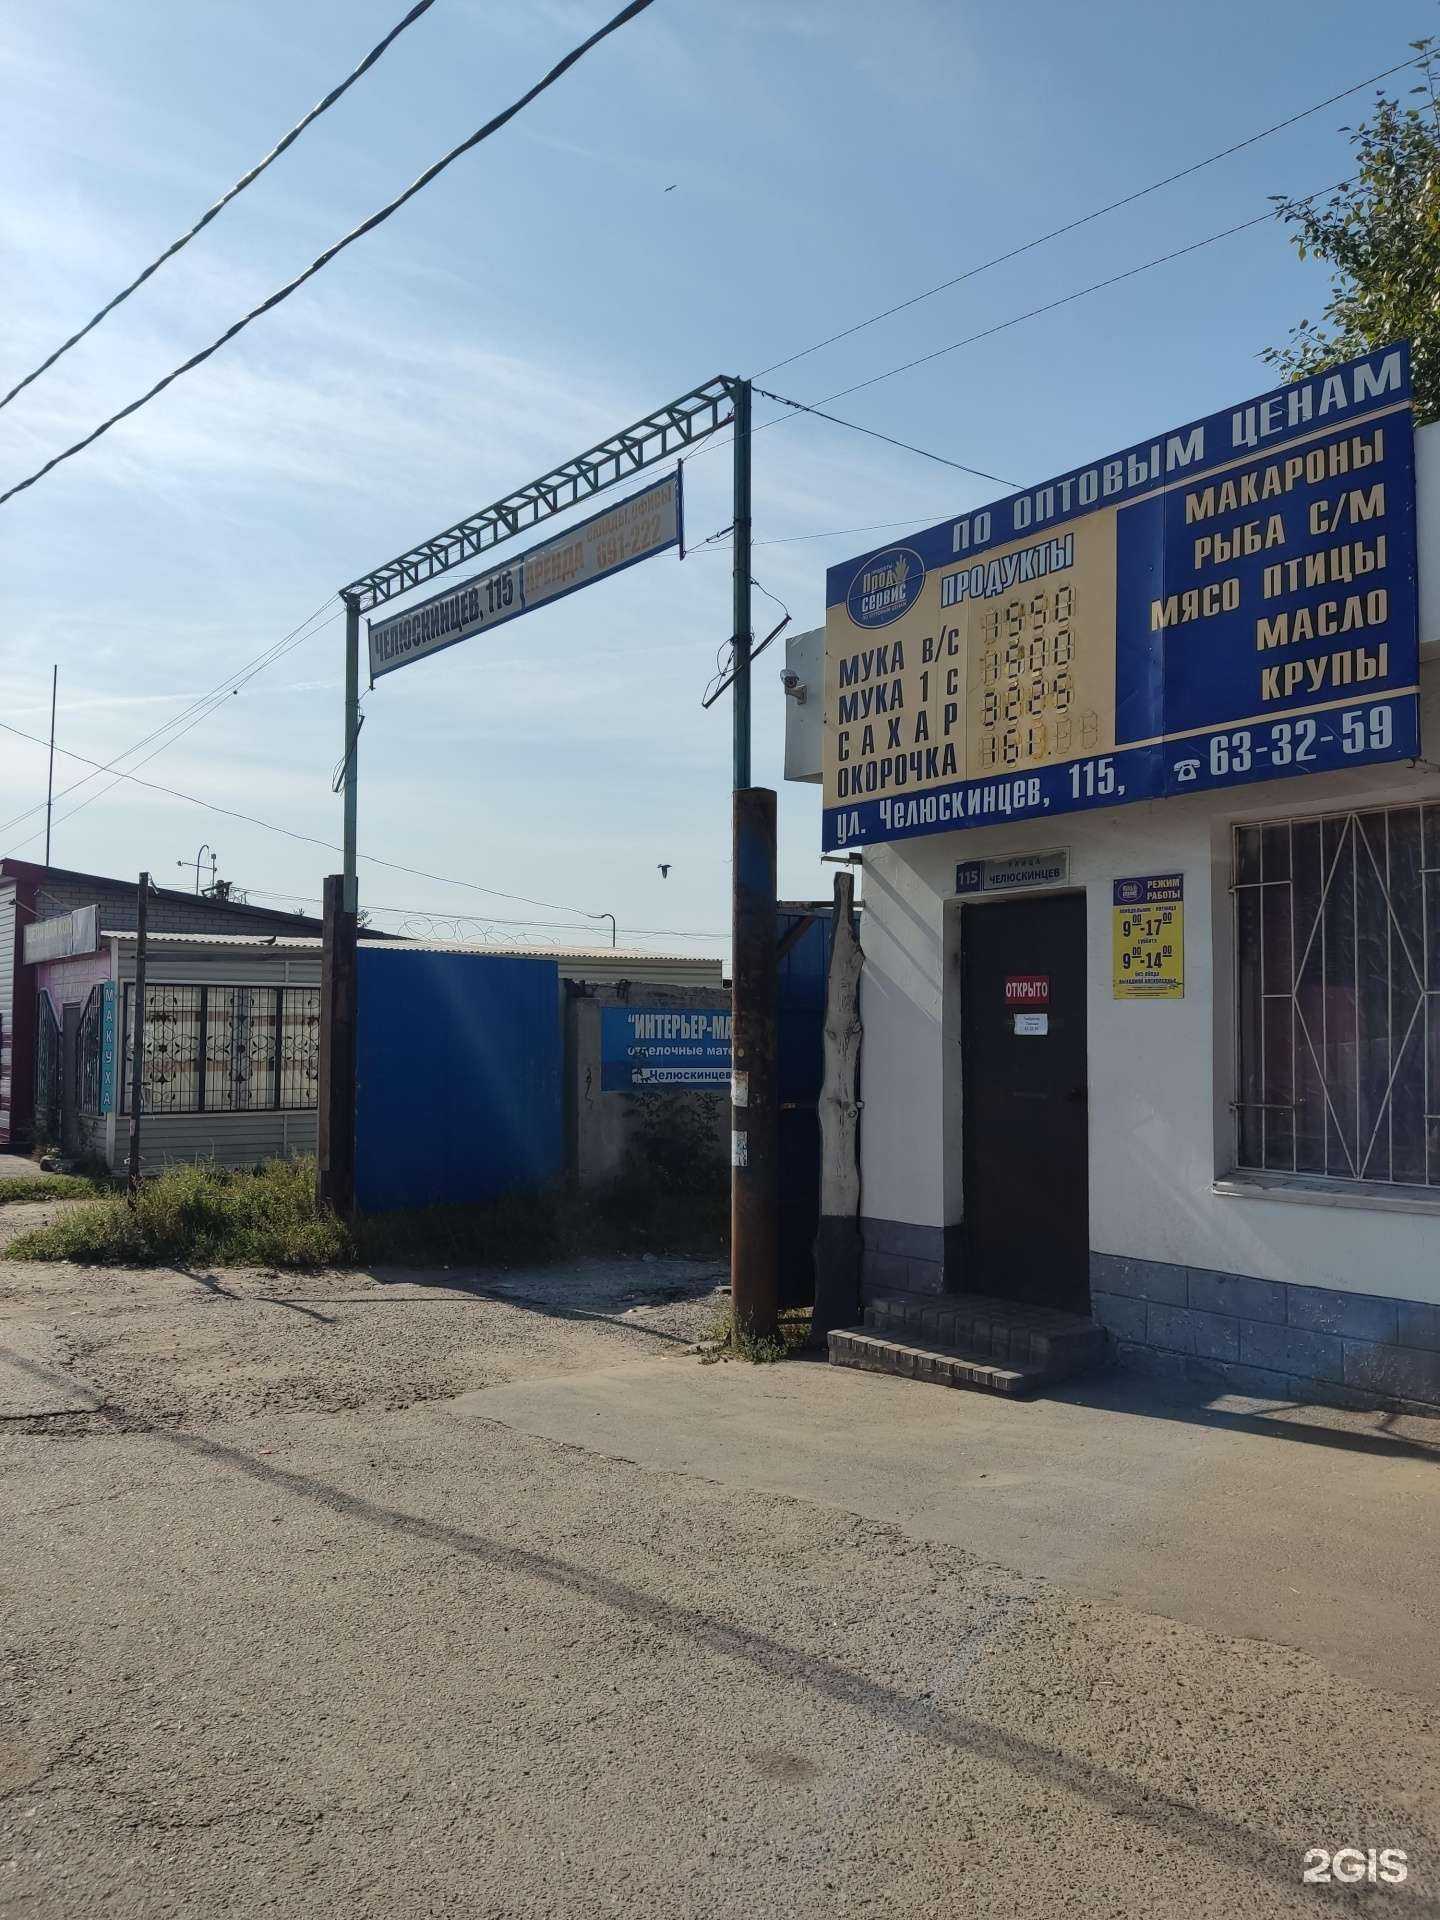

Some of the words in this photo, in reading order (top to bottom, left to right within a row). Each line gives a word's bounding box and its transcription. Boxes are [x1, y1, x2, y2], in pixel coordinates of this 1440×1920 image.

[952, 511, 992, 553] ПО
[1013, 426, 1205, 530] ОПТОВЫМ
[1231, 352, 1402, 448] ЦЕНАМ
[1185, 428, 1384, 525] МАКАРОНЫ
[1194, 513, 1286, 569] РЫБА
[1309, 483, 1386, 536] С/М
[940, 531, 1075, 608] ПРОДУКТЫ
[1151, 577, 1241, 632] МЯСО
[1263, 535, 1387, 600] ПТИЦЫ
[374, 585, 484, 661] ЧЕЛЮСКИНЦЕВ,
[485, 569, 514, 616] 115
[1257, 589, 1388, 651] МАСЛО
[838, 640, 905, 688] МУКА
[922, 624, 960, 664] В/С
[1262, 642, 1389, 701] КРУПЫ
[838, 678, 904, 725] МУКА
[919, 671, 929, 702] 1
[946, 668, 959, 696] С
[836, 812, 866, 845] ул.
[879, 776, 1050, 830] Челюскинцев,
[1068, 757, 1126, 797] 115,
[1209, 704, 1394, 776] 63-32-59
[837, 742, 958, 798] ОКОРОЧКА
[960, 870, 979, 885] 115
[990, 867, 1061, 885] ЧЕЛЮСКИНЦЕВ
[1147, 878, 1180, 889] РЕЖИМ
[1147, 890, 1180, 900] РАБОТЫ
[1006, 981, 1048, 998] ОТКРЫТО
[103, 989, 113, 1105] МАКУХА
